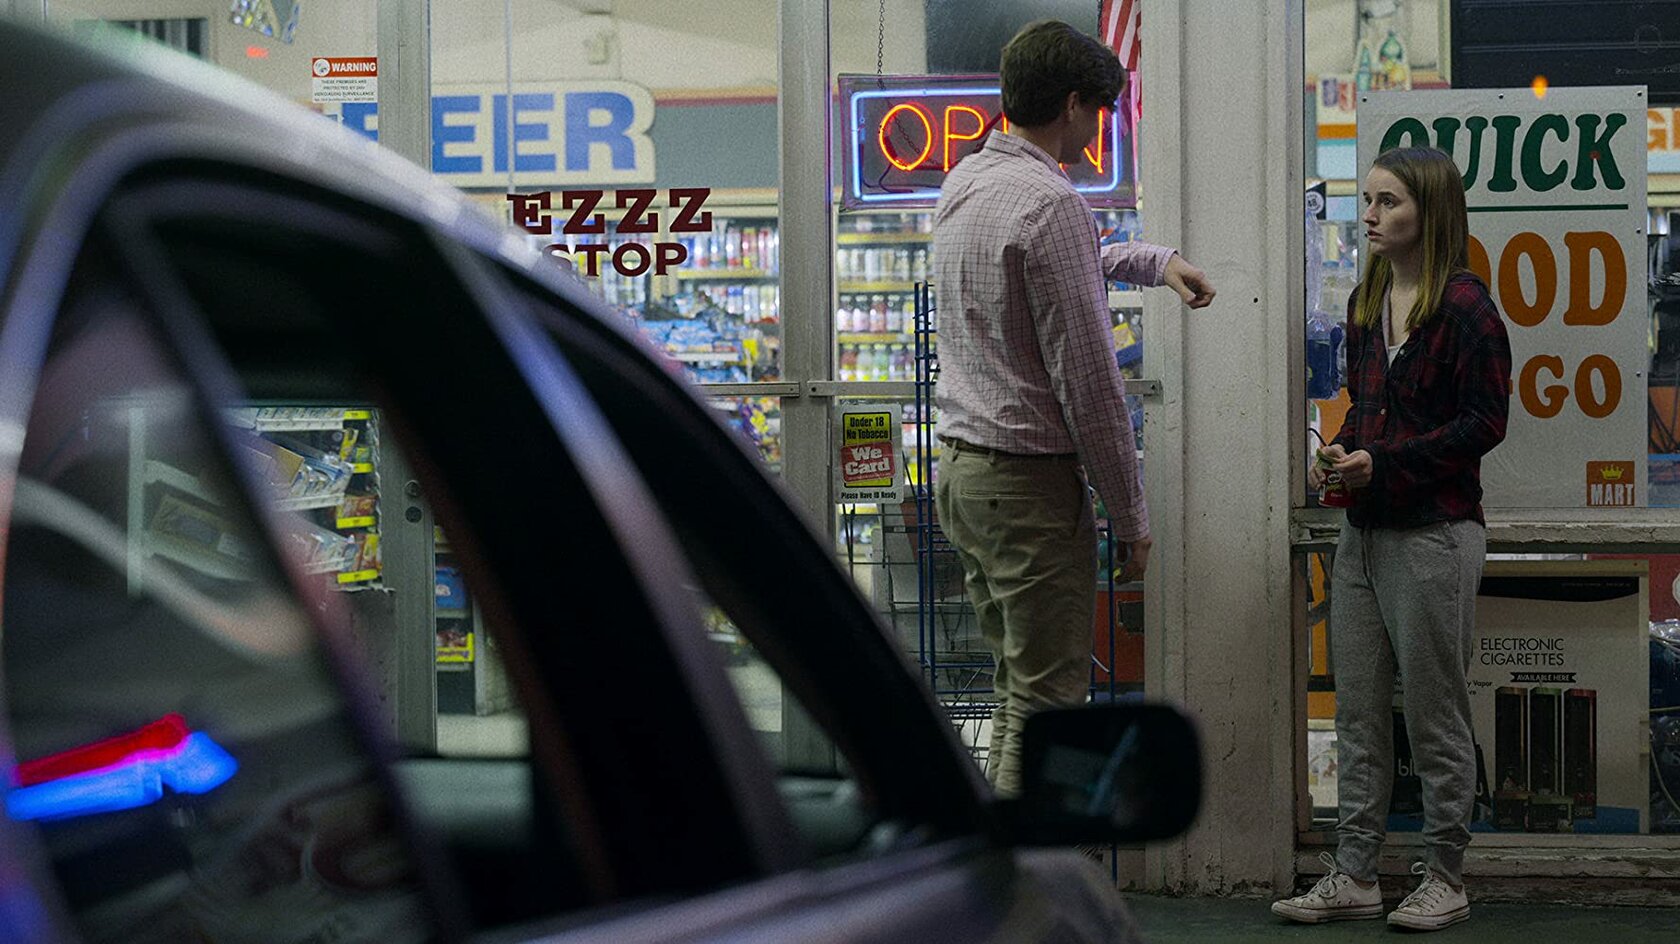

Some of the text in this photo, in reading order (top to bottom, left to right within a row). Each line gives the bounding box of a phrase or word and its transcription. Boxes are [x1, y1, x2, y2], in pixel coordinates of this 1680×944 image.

[332, 63, 376, 72] WARNING
[879, 103, 1104, 174] OPN
[507, 188, 712, 234] EZZZ
[850, 416, 884, 427] Under 18
[847, 428, 888, 439] No Tobacco
[851, 446, 882, 461] We
[845, 458, 890, 475] Card
[841, 491, 858, 499] Please
[859, 491, 872, 499] Have
[881, 491, 897, 500] Ready
[1590, 483, 1634, 505] MART
[1480, 637, 1565, 651] ELECTRONIC
[1480, 652, 1565, 666] CIGARETTES
[1472, 680, 1492, 688] Vapor
[1516, 673, 1570, 682] AVAILABLE HERE
[1398, 758, 1416, 777] bl
